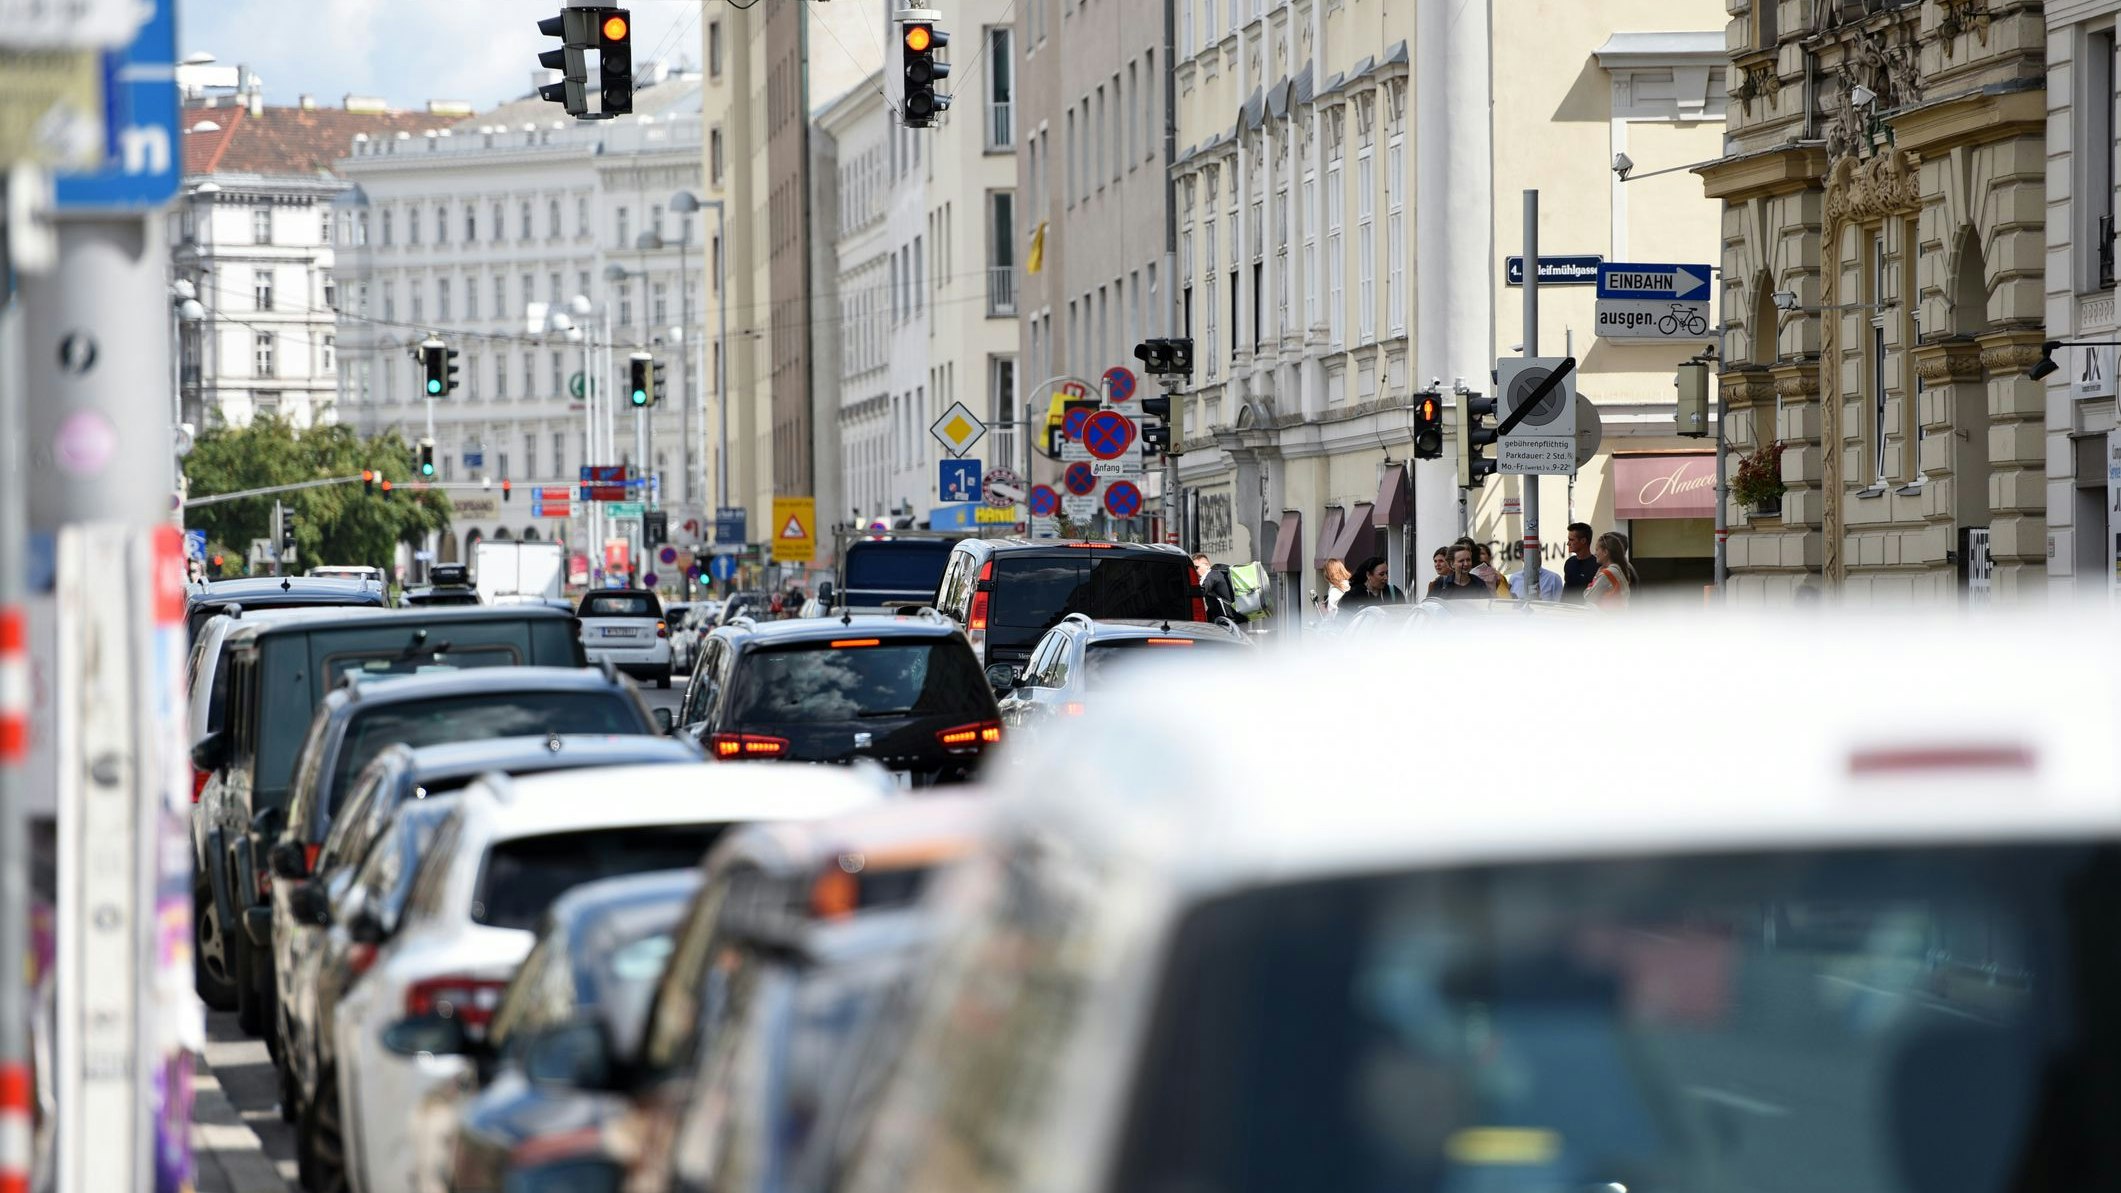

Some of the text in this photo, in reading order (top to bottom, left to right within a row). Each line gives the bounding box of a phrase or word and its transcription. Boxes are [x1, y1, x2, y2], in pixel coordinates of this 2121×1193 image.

[1537, 264, 1598, 277] leifmühlgass
[1609, 274, 1673, 290] EINBAHN
[1600, 311, 1657, 329] ausgen.
[1504, 440, 1569, 449] gebührenpflichtig
[1505, 451, 1545, 460] Parkdauer:
[1546, 452, 1551, 460] 2
[1552, 452, 1567, 460] Std.
[1094, 463, 1120, 474] Anfang
[1638, 461, 1718, 505] Amaco
[1970, 533, 1991, 579] HOTE
